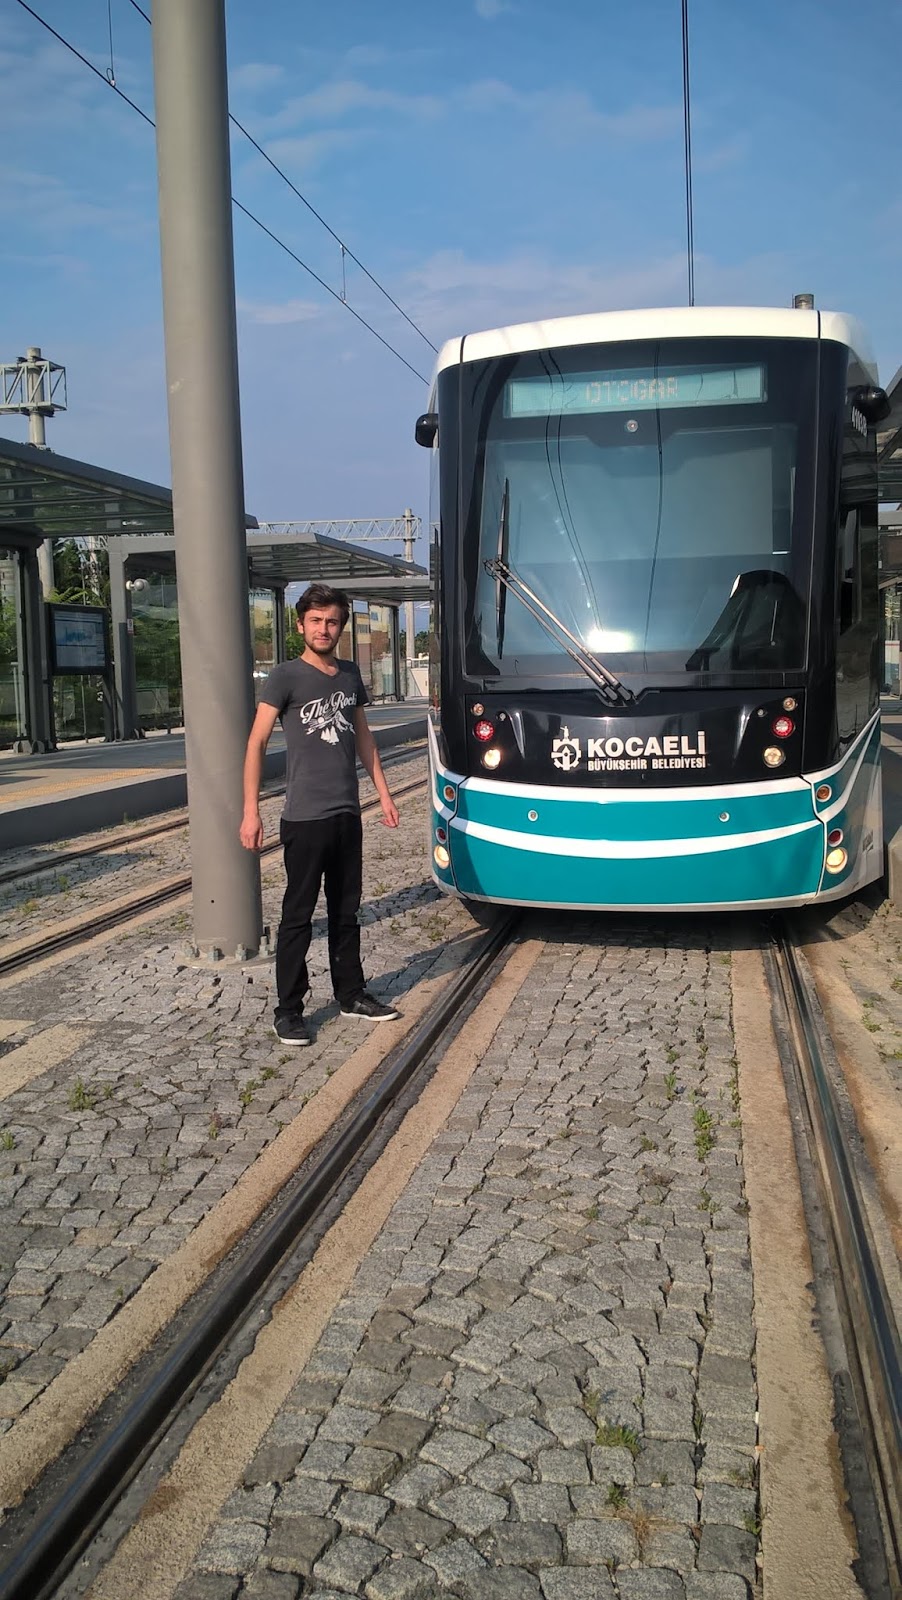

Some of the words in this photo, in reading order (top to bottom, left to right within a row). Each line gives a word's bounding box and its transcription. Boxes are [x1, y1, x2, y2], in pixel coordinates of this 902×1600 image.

[586, 377, 678, 404] OTOGAR
[300, 698, 330, 724] The
[587, 731, 707, 757] KOCAELİ
[587, 757, 648, 771] BÜYÜKŞEHİR
[652, 756, 706, 770] BELEDİYESİ
